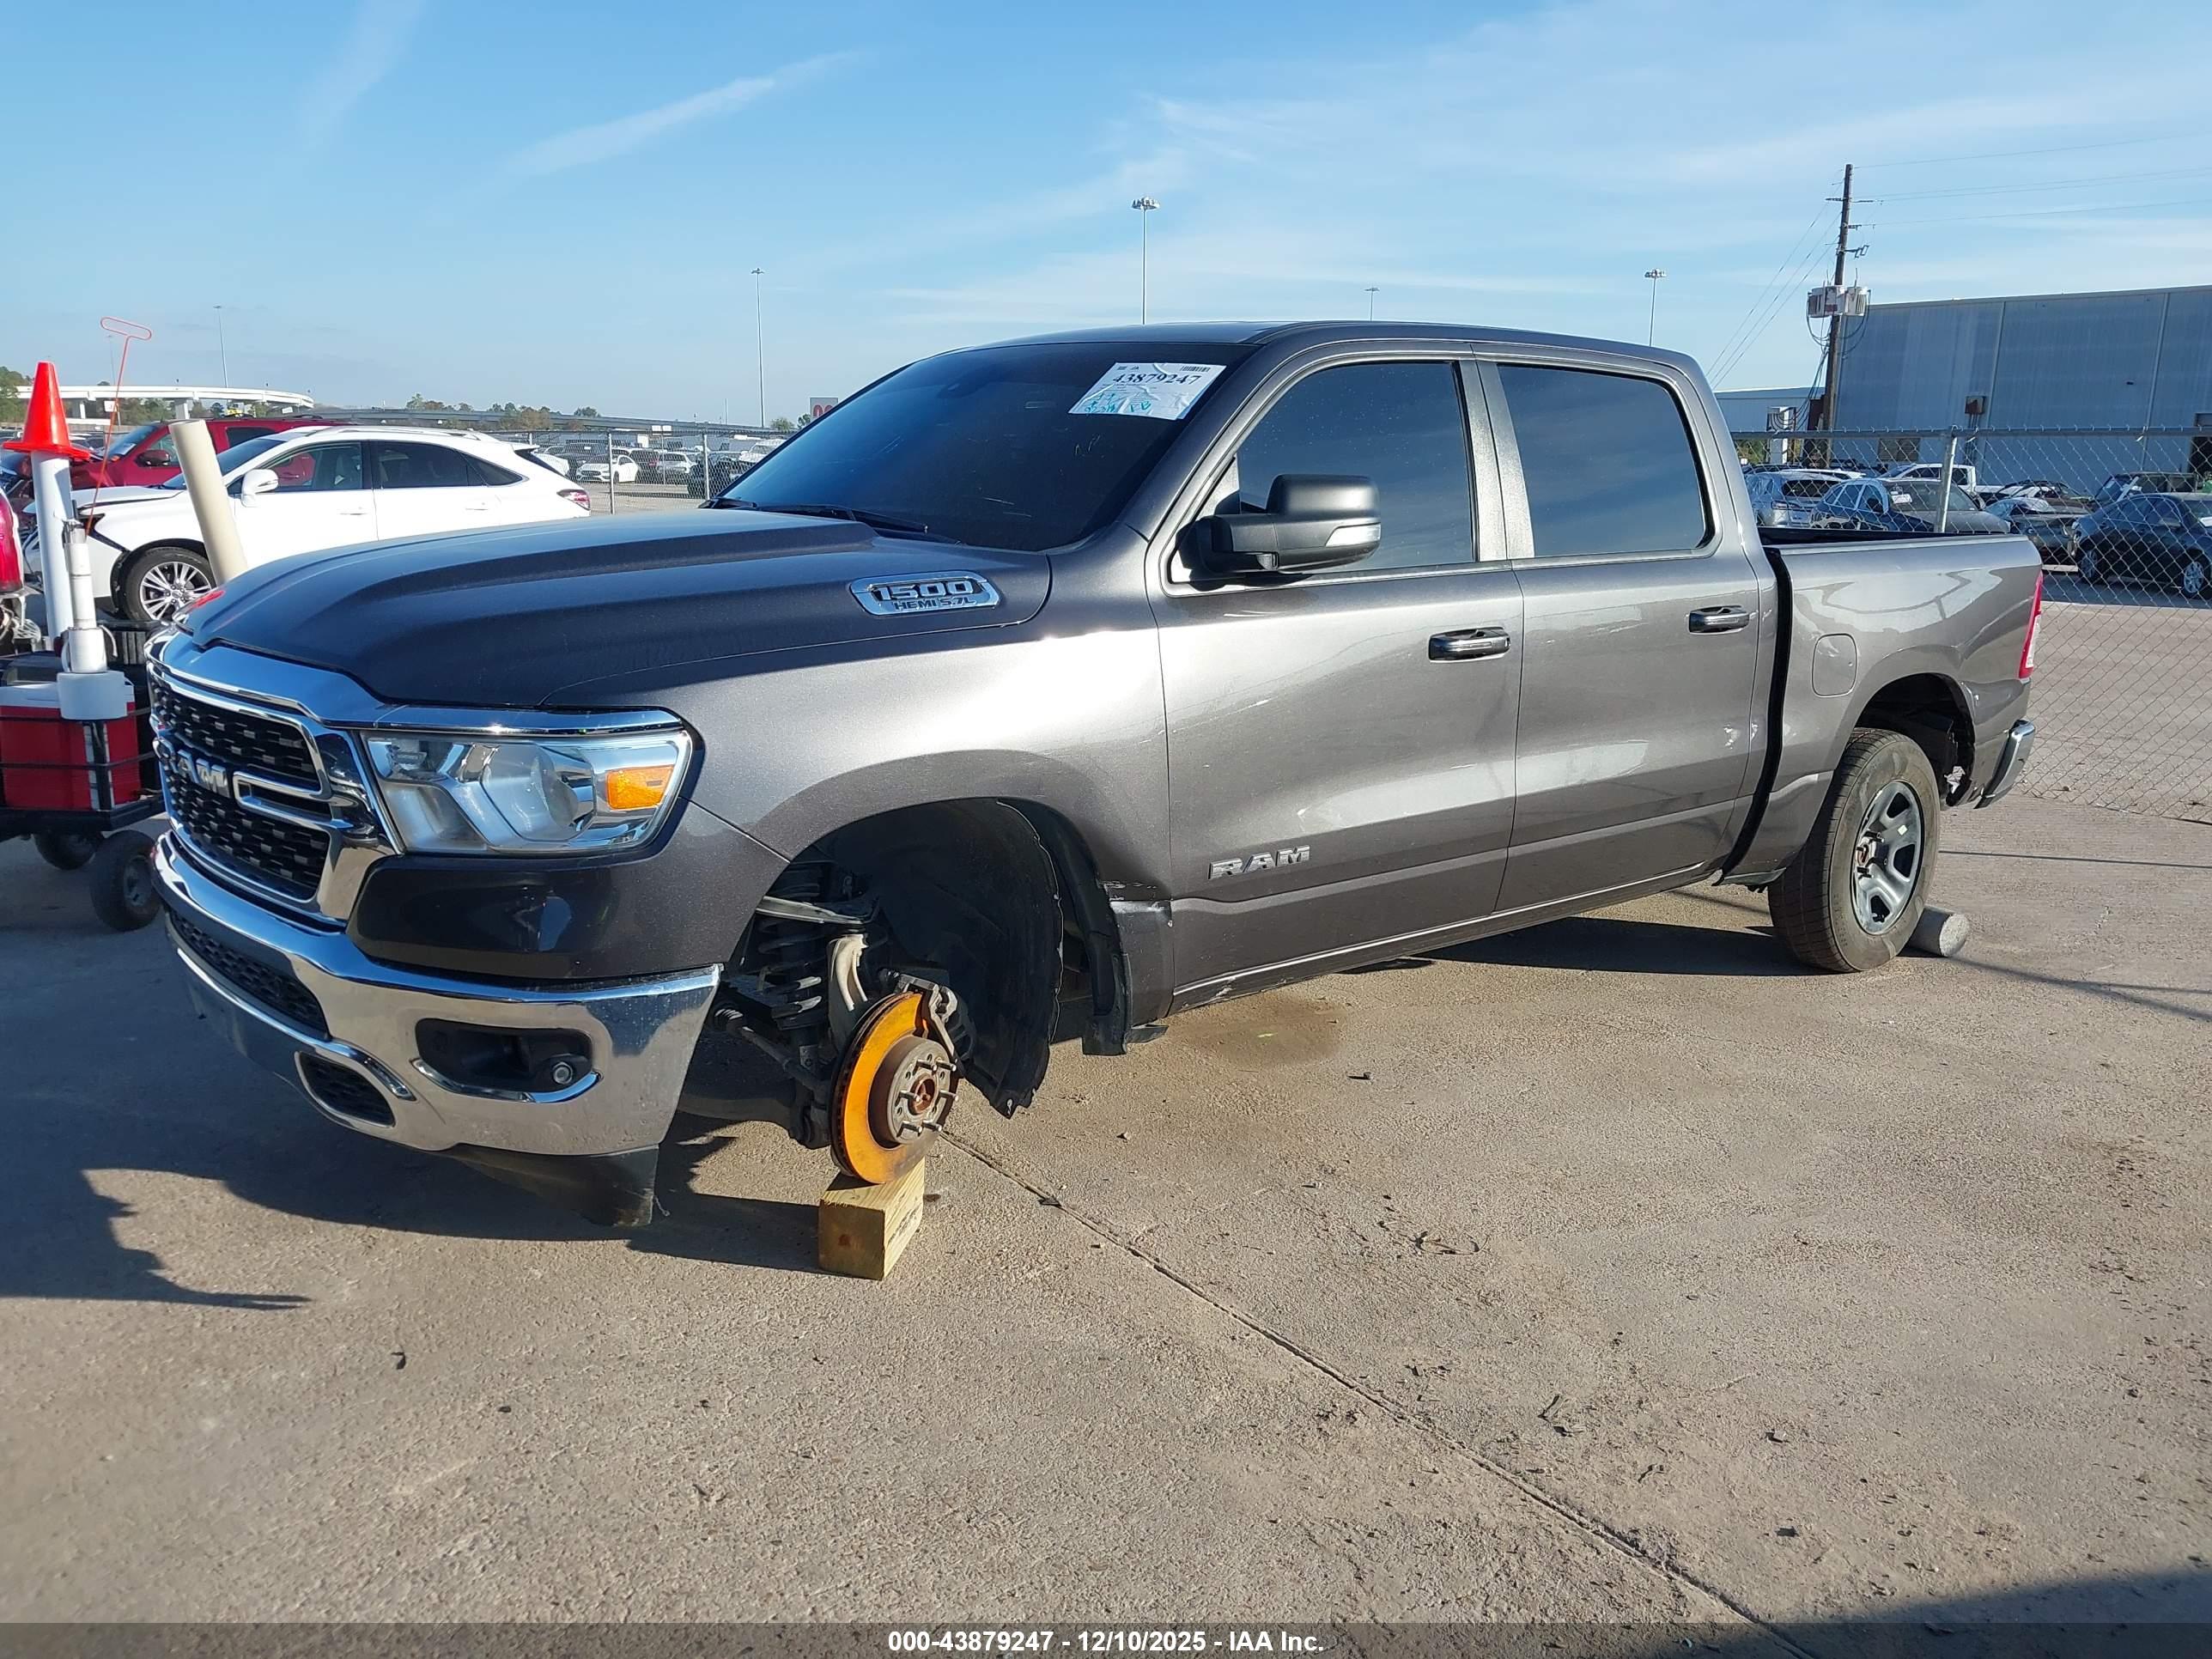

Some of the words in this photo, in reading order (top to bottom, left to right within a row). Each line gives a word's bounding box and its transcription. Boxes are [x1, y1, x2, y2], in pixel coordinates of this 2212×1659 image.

[1113, 373, 1200, 386] 43879247
[875, 581, 973, 600] 1500
[895, 599, 936, 611] HEMI
[939, 596, 976, 606] 5.7L
[1207, 845, 1310, 880] RAM
